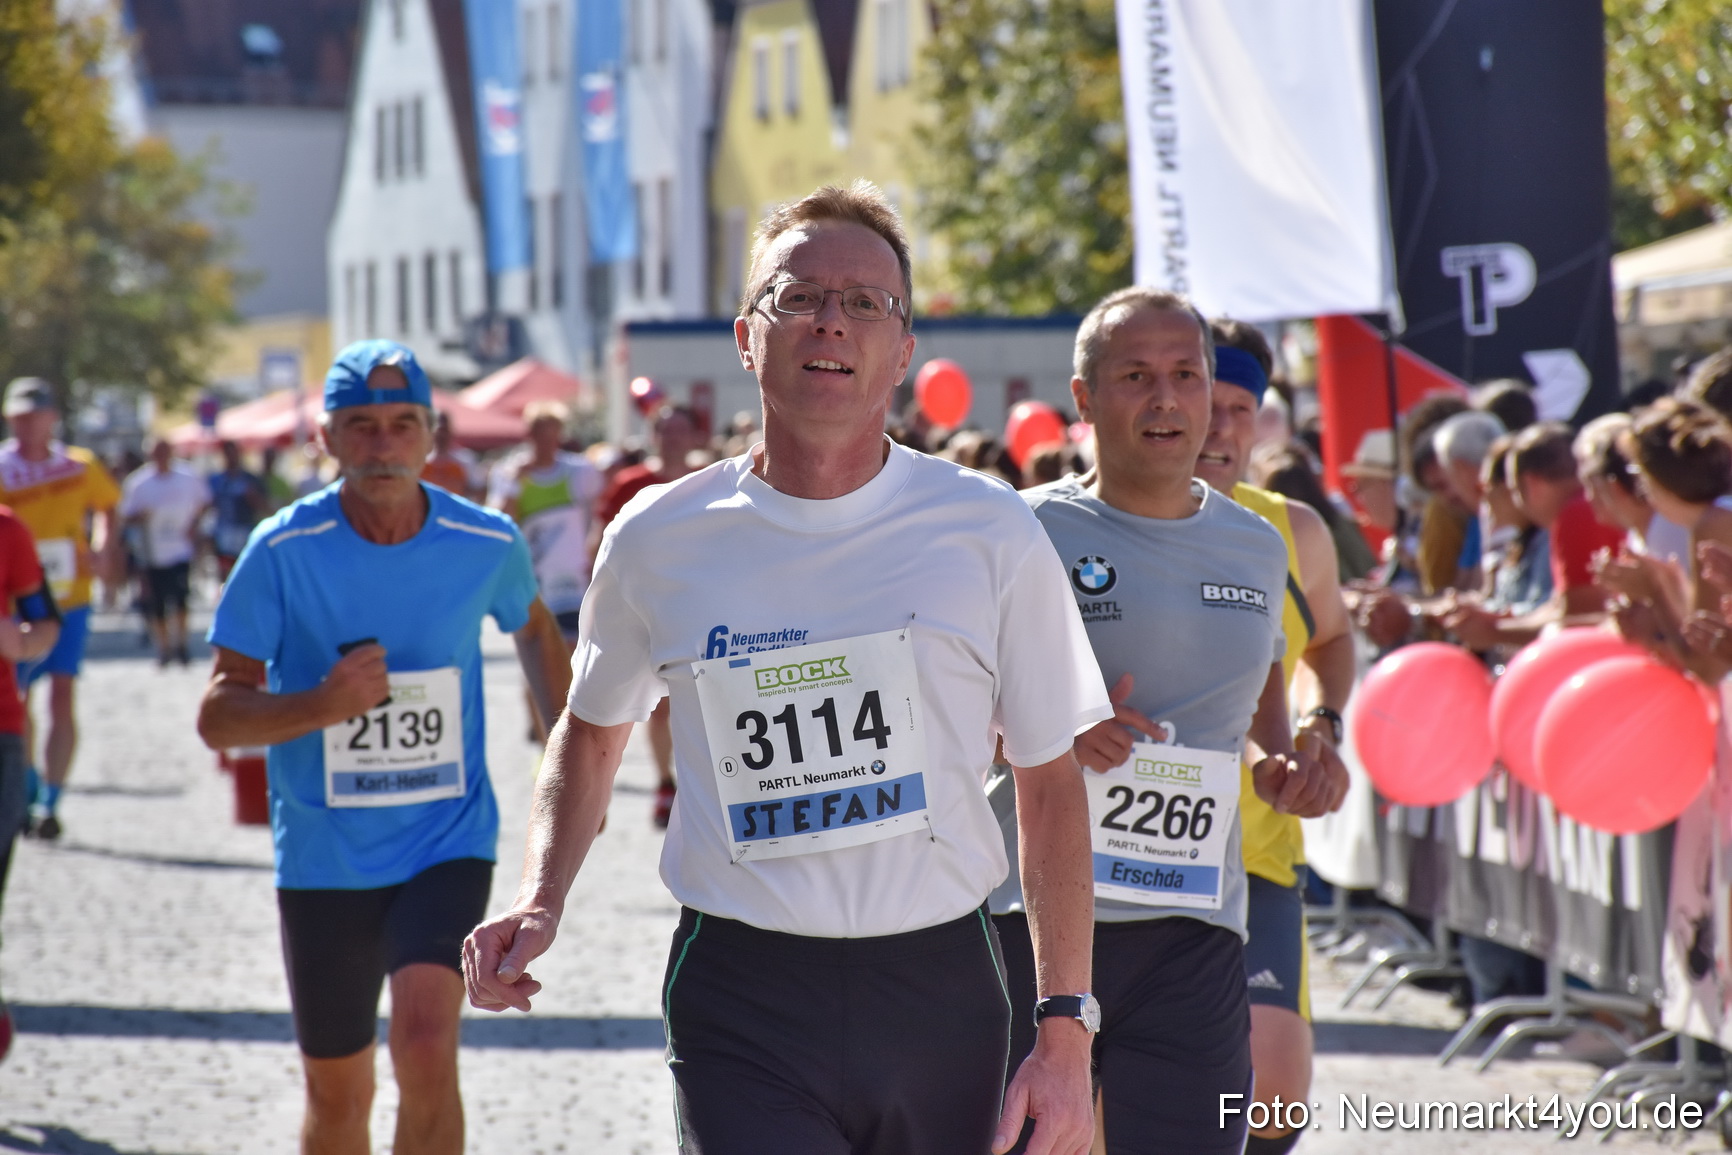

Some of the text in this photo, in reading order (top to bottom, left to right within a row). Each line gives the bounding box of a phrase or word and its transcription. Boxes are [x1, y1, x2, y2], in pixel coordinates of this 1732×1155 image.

[1078, 601, 1122, 614] ARTL
[1201, 583, 1267, 610] BOCK
[1082, 613, 1122, 623] eumarkt
[731, 628, 809, 647] Neumarkter
[755, 656, 851, 690] BOCK
[757, 677, 853, 698] inspired by smart concepts
[347, 707, 443, 751] 2139
[736, 690, 892, 771] 3114
[355, 773, 438, 791] Karl-Heinz
[758, 774, 801, 792] PARTL
[803, 765, 867, 785] Neumarkt
[1135, 758, 1203, 782] BOCK
[743, 783, 901, 838] STEFAN
[1100, 785, 1216, 841] 2266
[1107, 839, 1187, 858] PARTL Neumarkt
[1110, 861, 1185, 889] Erschda
